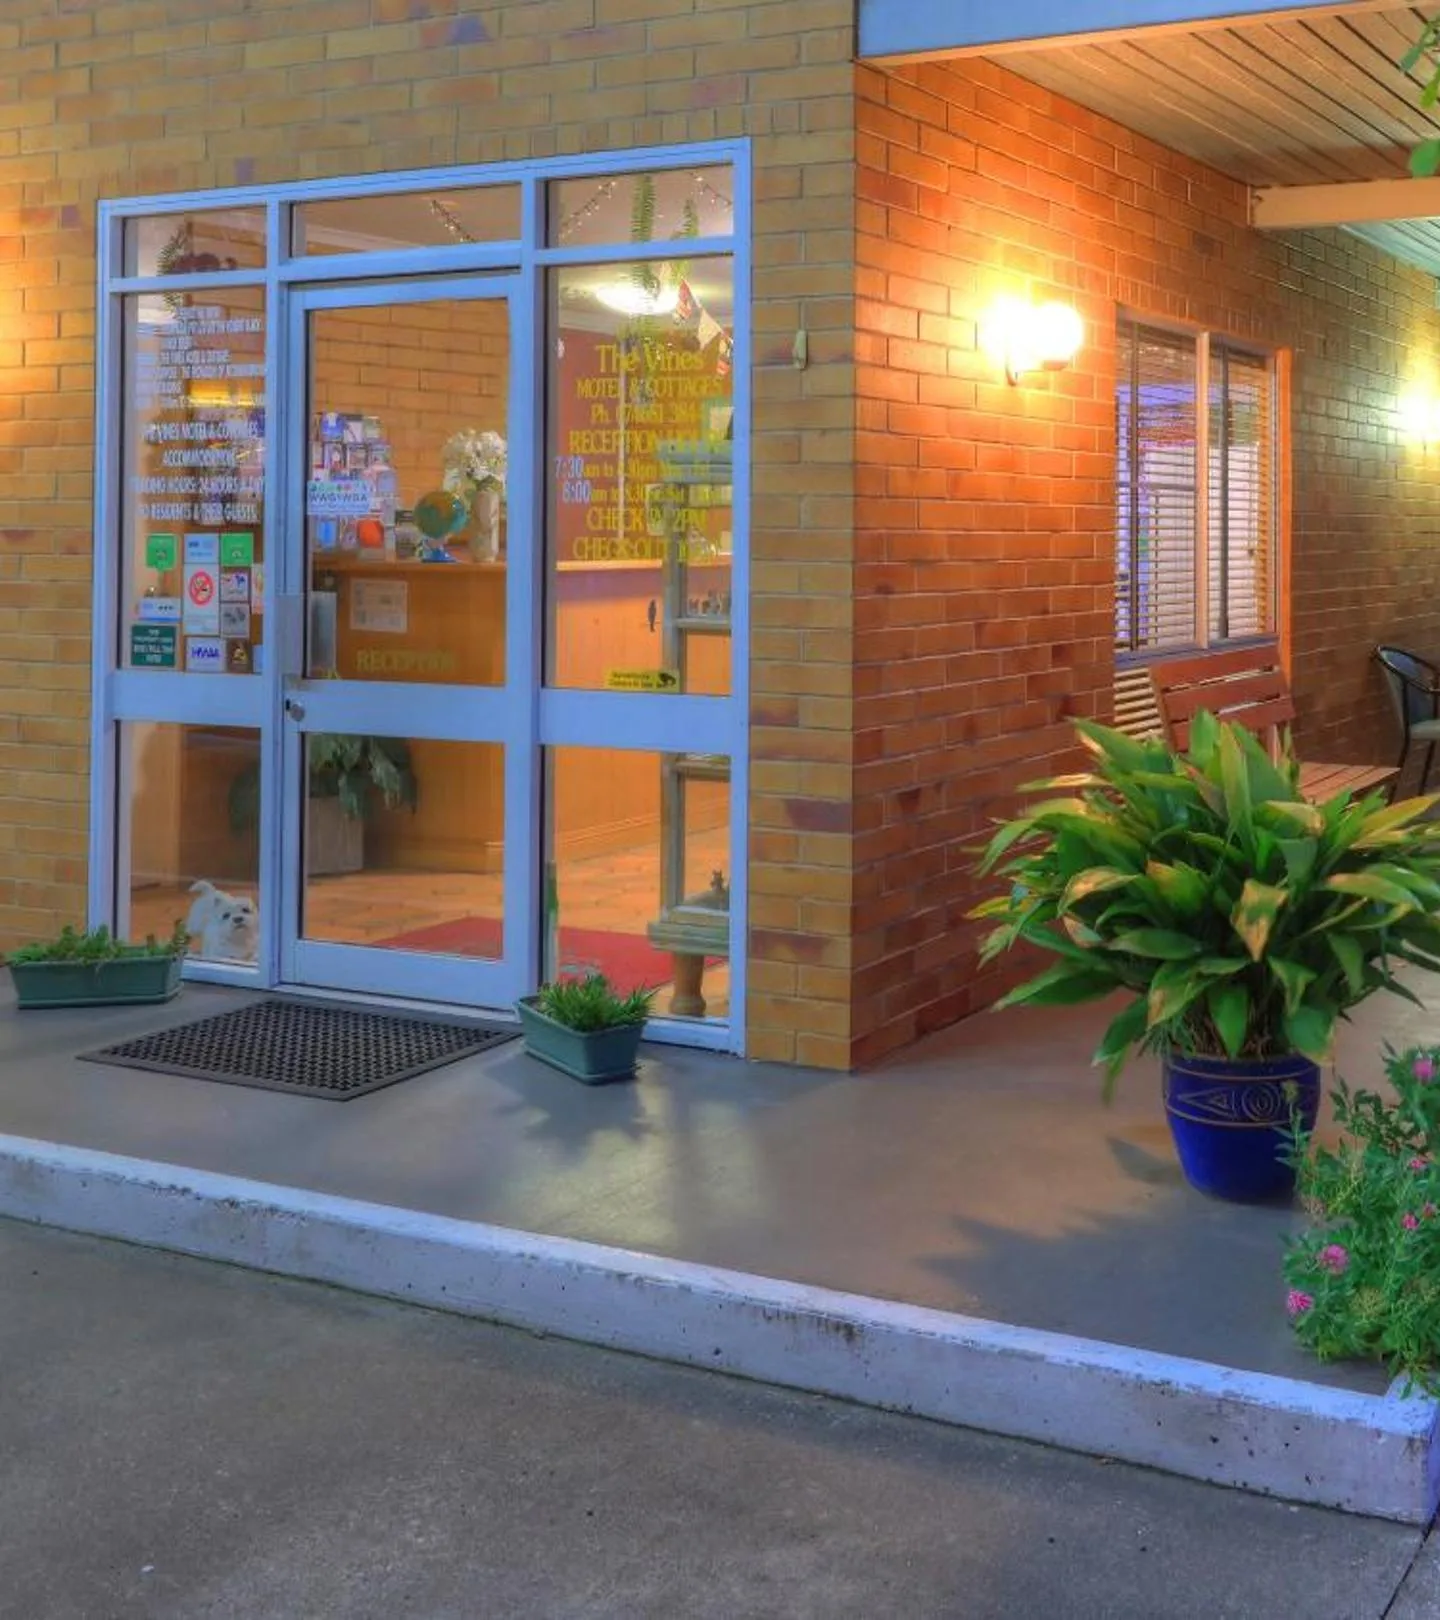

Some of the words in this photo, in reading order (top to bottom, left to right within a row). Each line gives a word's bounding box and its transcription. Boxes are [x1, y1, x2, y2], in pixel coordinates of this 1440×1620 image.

[595, 344, 641, 373] The
[643, 343, 705, 373] Vines
[569, 430, 657, 454] RECEPTION
[586, 507, 645, 532] CHECK
